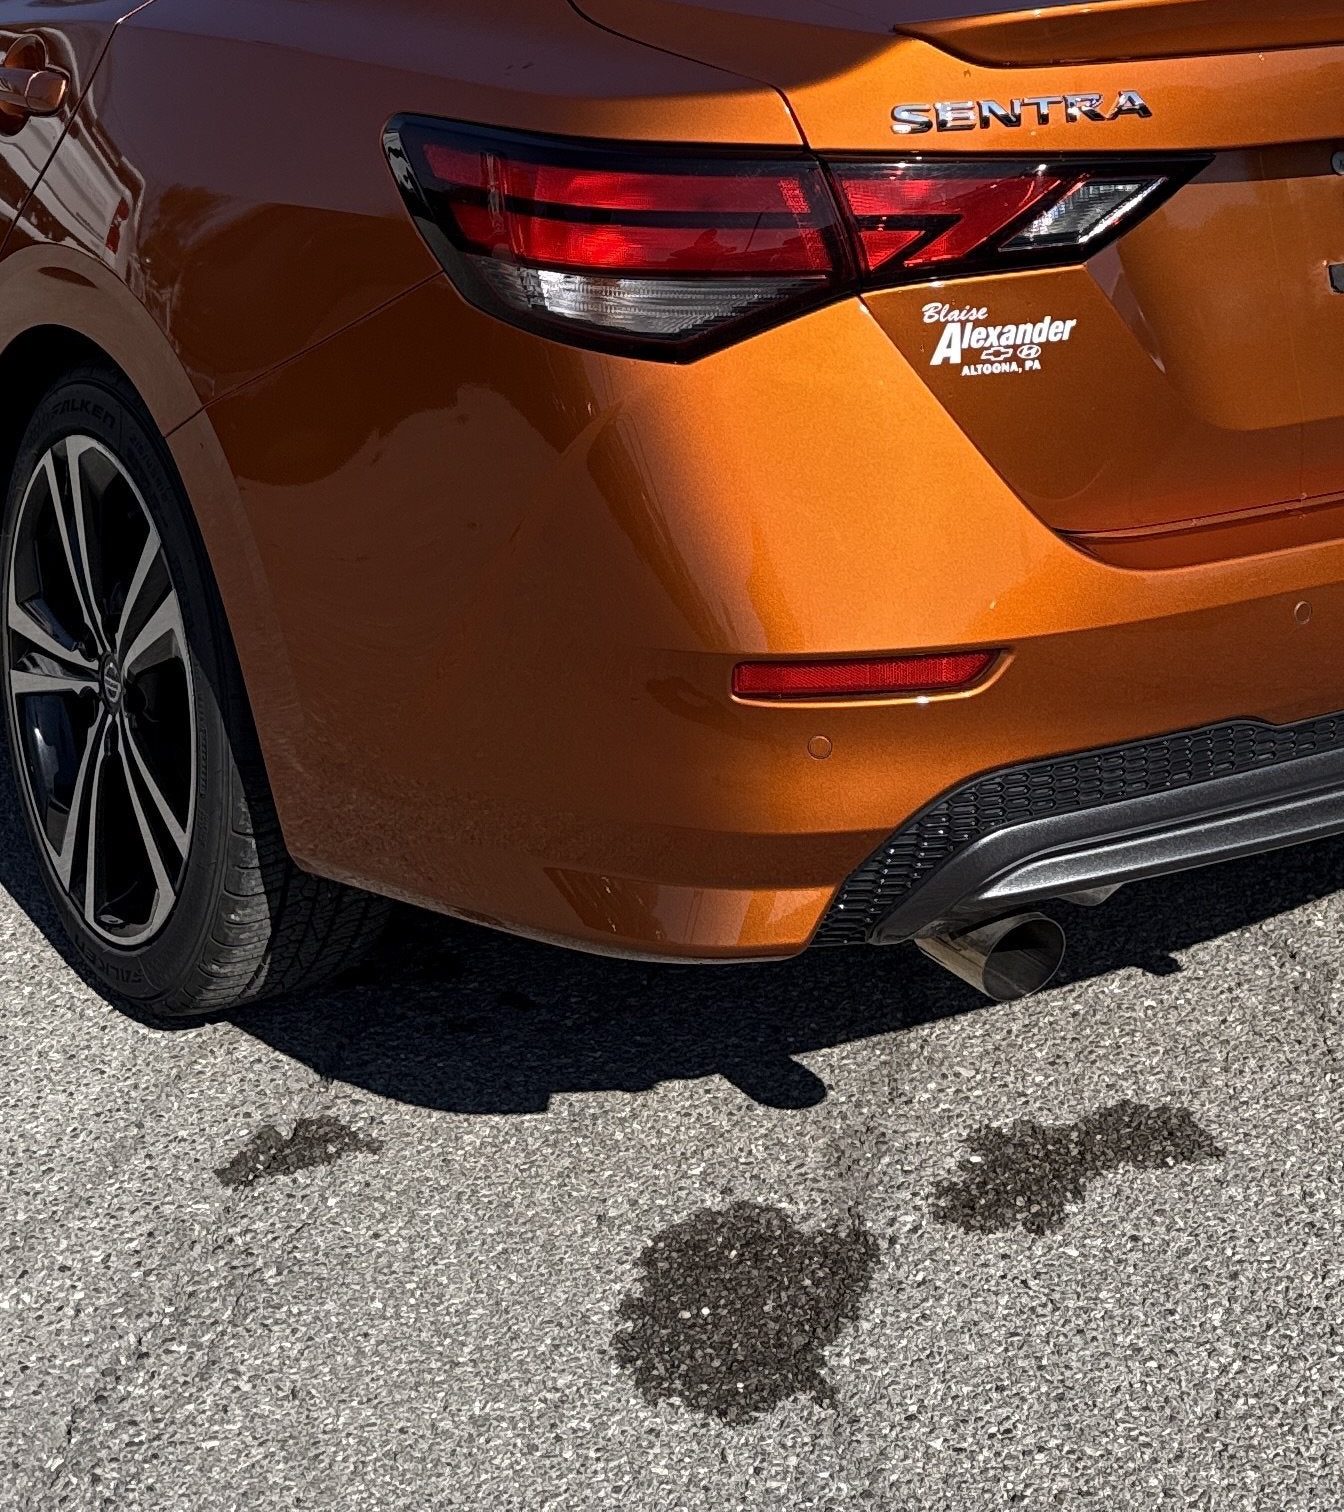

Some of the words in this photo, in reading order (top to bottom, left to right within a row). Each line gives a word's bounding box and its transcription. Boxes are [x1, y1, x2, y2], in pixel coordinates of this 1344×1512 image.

[891, 89, 1153, 134] SENTRA
[921, 302, 988, 324] Blaise
[930, 316, 1077, 366] Alexander
[961, 362, 1022, 376] ALTOONA,
[1025, 359, 1041, 371] PA
